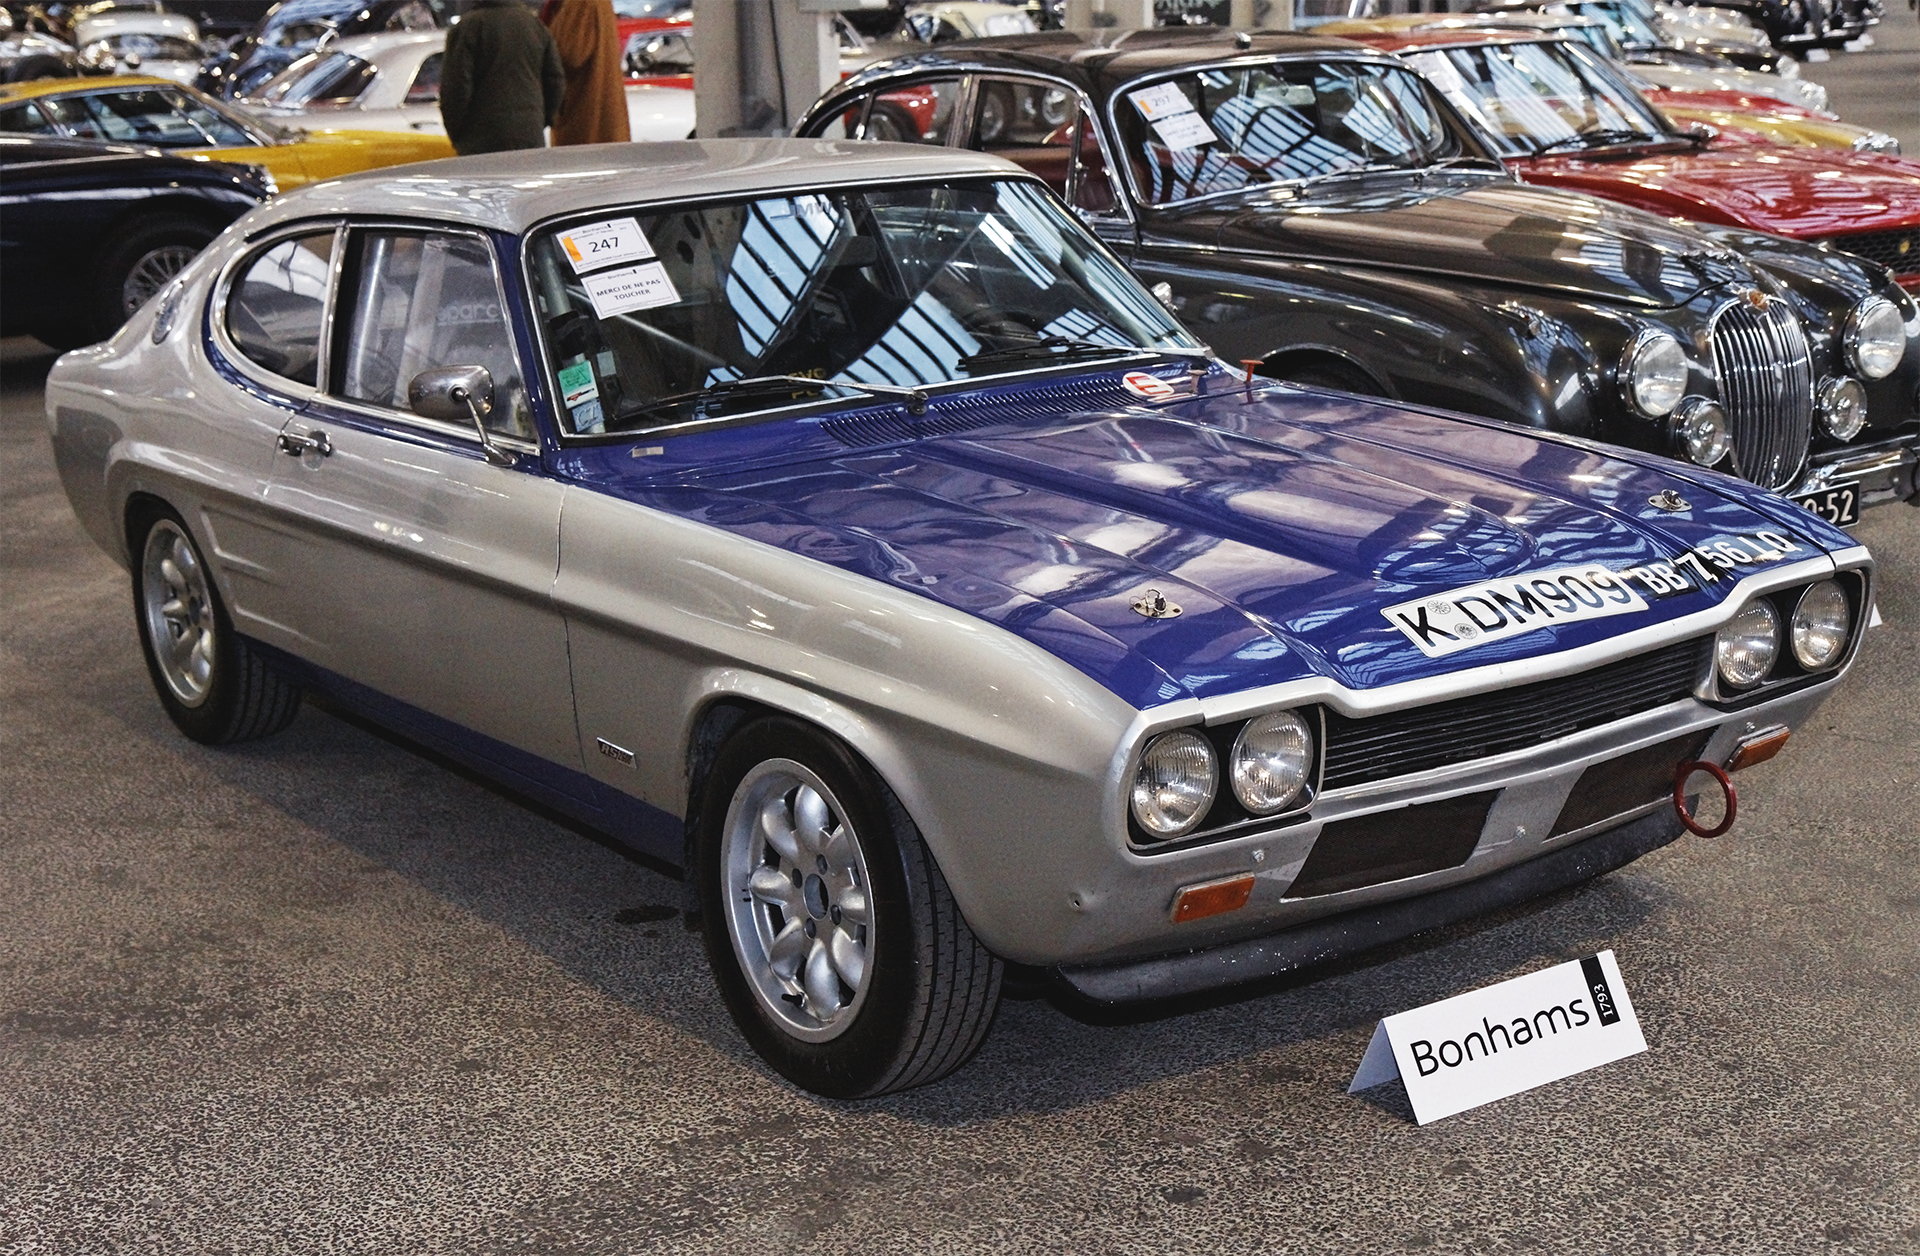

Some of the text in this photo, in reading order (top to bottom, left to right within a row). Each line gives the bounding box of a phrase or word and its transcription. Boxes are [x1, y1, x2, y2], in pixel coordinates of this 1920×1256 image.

[588, 236, 619, 253] 247
[596, 286, 621, 297] MERCI
[614, 289, 651, 300] TOUCHER
[1628, 562, 1690, 595] BB
[1673, 540, 1753, 582] 756
[1396, 606, 1460, 648] K
[1593, 983, 1615, 1018] 1793
[1409, 998, 1591, 1078] Bonhams
